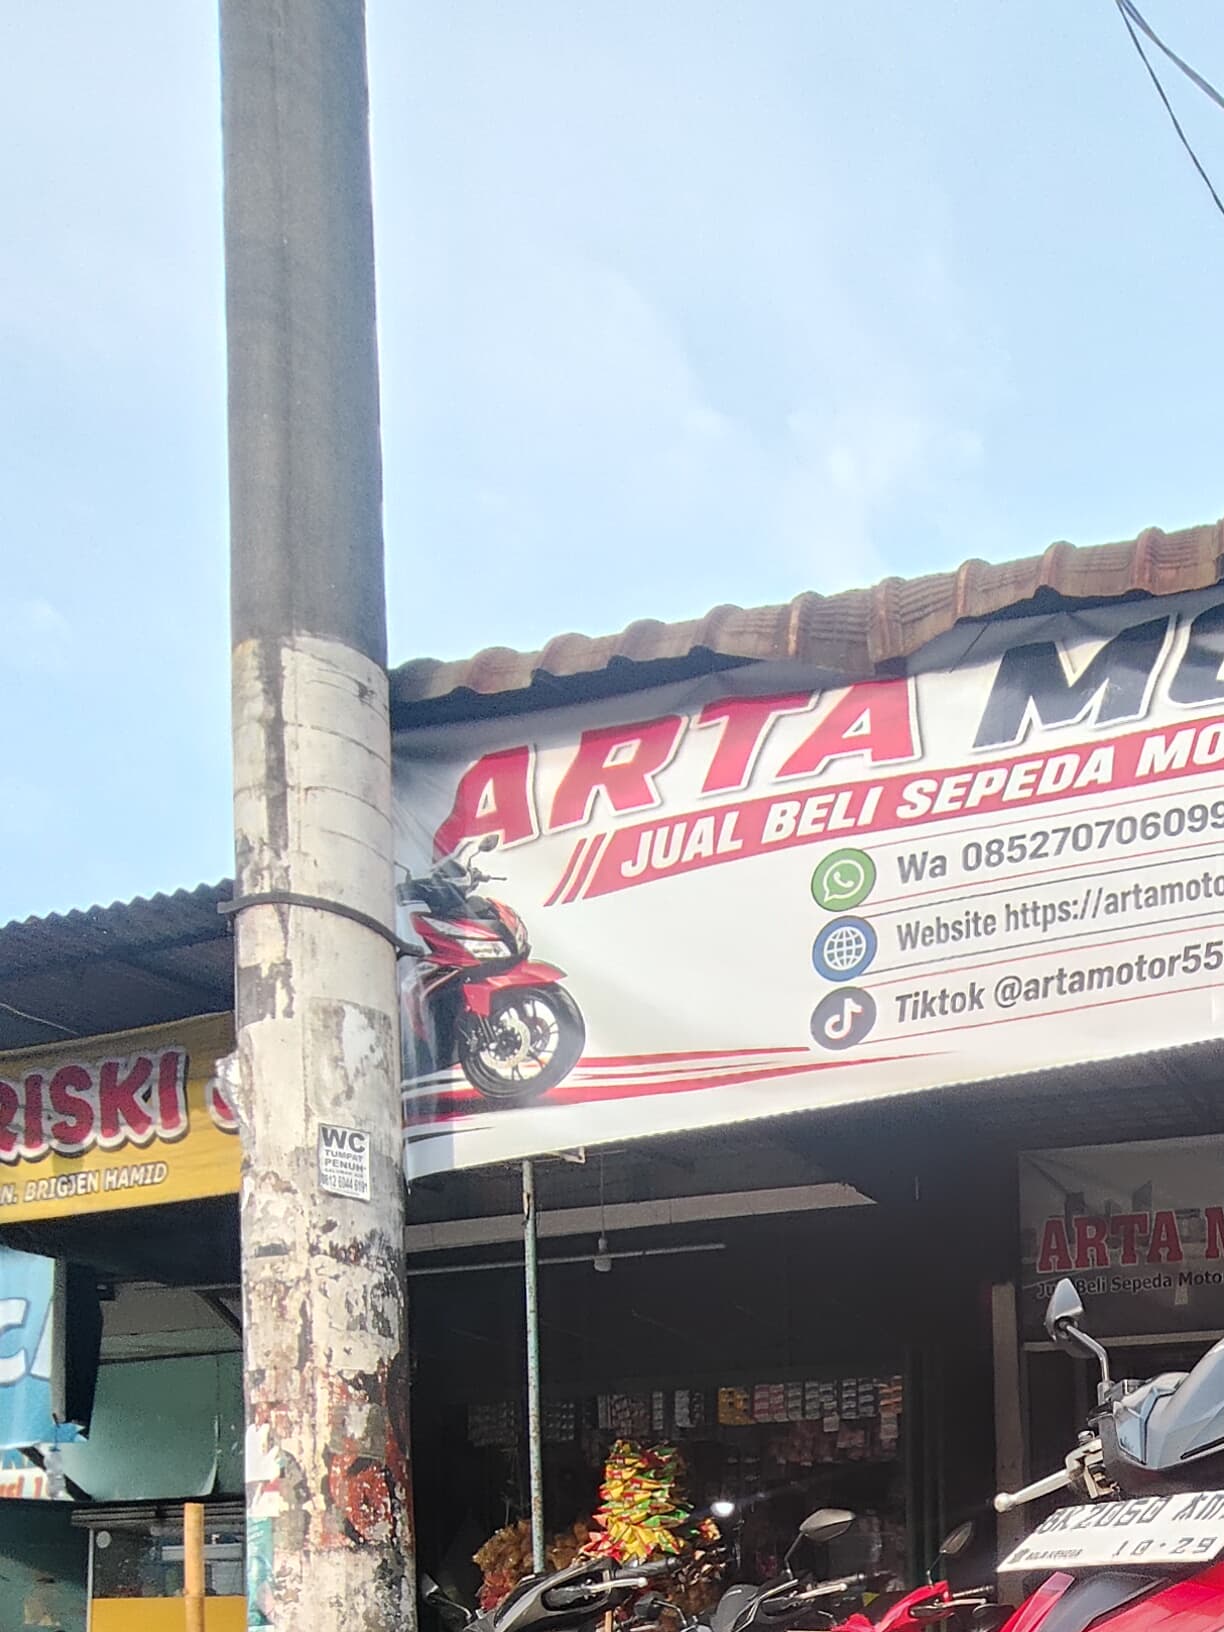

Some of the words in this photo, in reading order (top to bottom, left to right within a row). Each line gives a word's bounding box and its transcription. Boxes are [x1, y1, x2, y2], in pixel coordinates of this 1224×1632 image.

[432, 676, 918, 862] ARTA
[620, 823, 734, 878] JUAL
[761, 781, 881, 843] BELI
[895, 755, 1113, 819] SEPEDA
[897, 851, 948, 883] Wa
[897, 910, 996, 950] Website
[895, 982, 986, 1023] Tiktok
[994, 940, 1224, 1008] @artamotor55
[321, 1126, 366, 1153] WC
[24, 1171, 100, 1202] BRIGJEN
[103, 1162, 168, 1191] HAMID
[1036, 1210, 1184, 1273] ARTA
[1077, 1275, 1106, 1295] Beli
[1110, 1274, 1173, 1298] Sepeda
